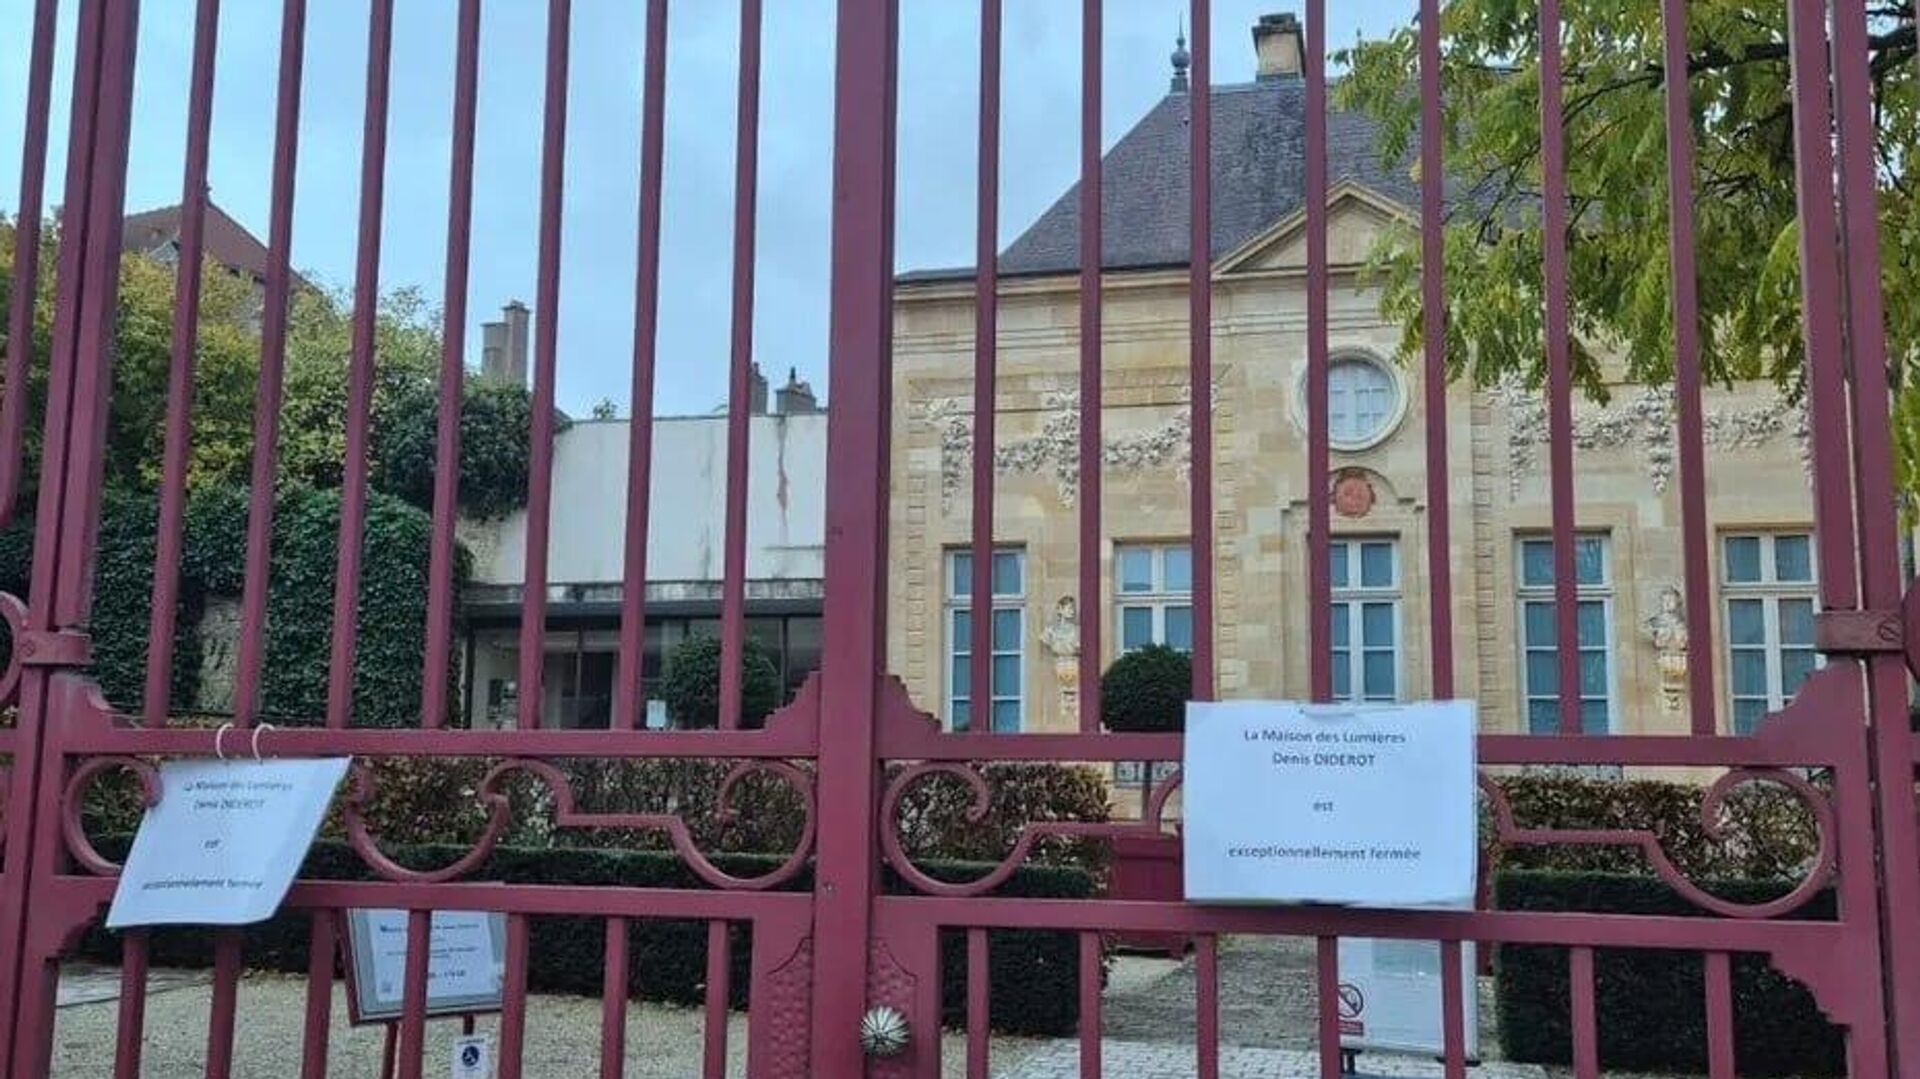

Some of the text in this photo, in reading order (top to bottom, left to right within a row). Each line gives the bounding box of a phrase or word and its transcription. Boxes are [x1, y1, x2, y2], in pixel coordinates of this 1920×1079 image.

[1244, 730, 1259, 742] La
[1262, 730, 1312, 743] Maison
[1315, 731, 1340, 743] des
[1272, 752, 1376, 767] Denis DIDEROT
[1313, 800, 1334, 812] est
[1228, 845, 1366, 861] exceptionnellement
